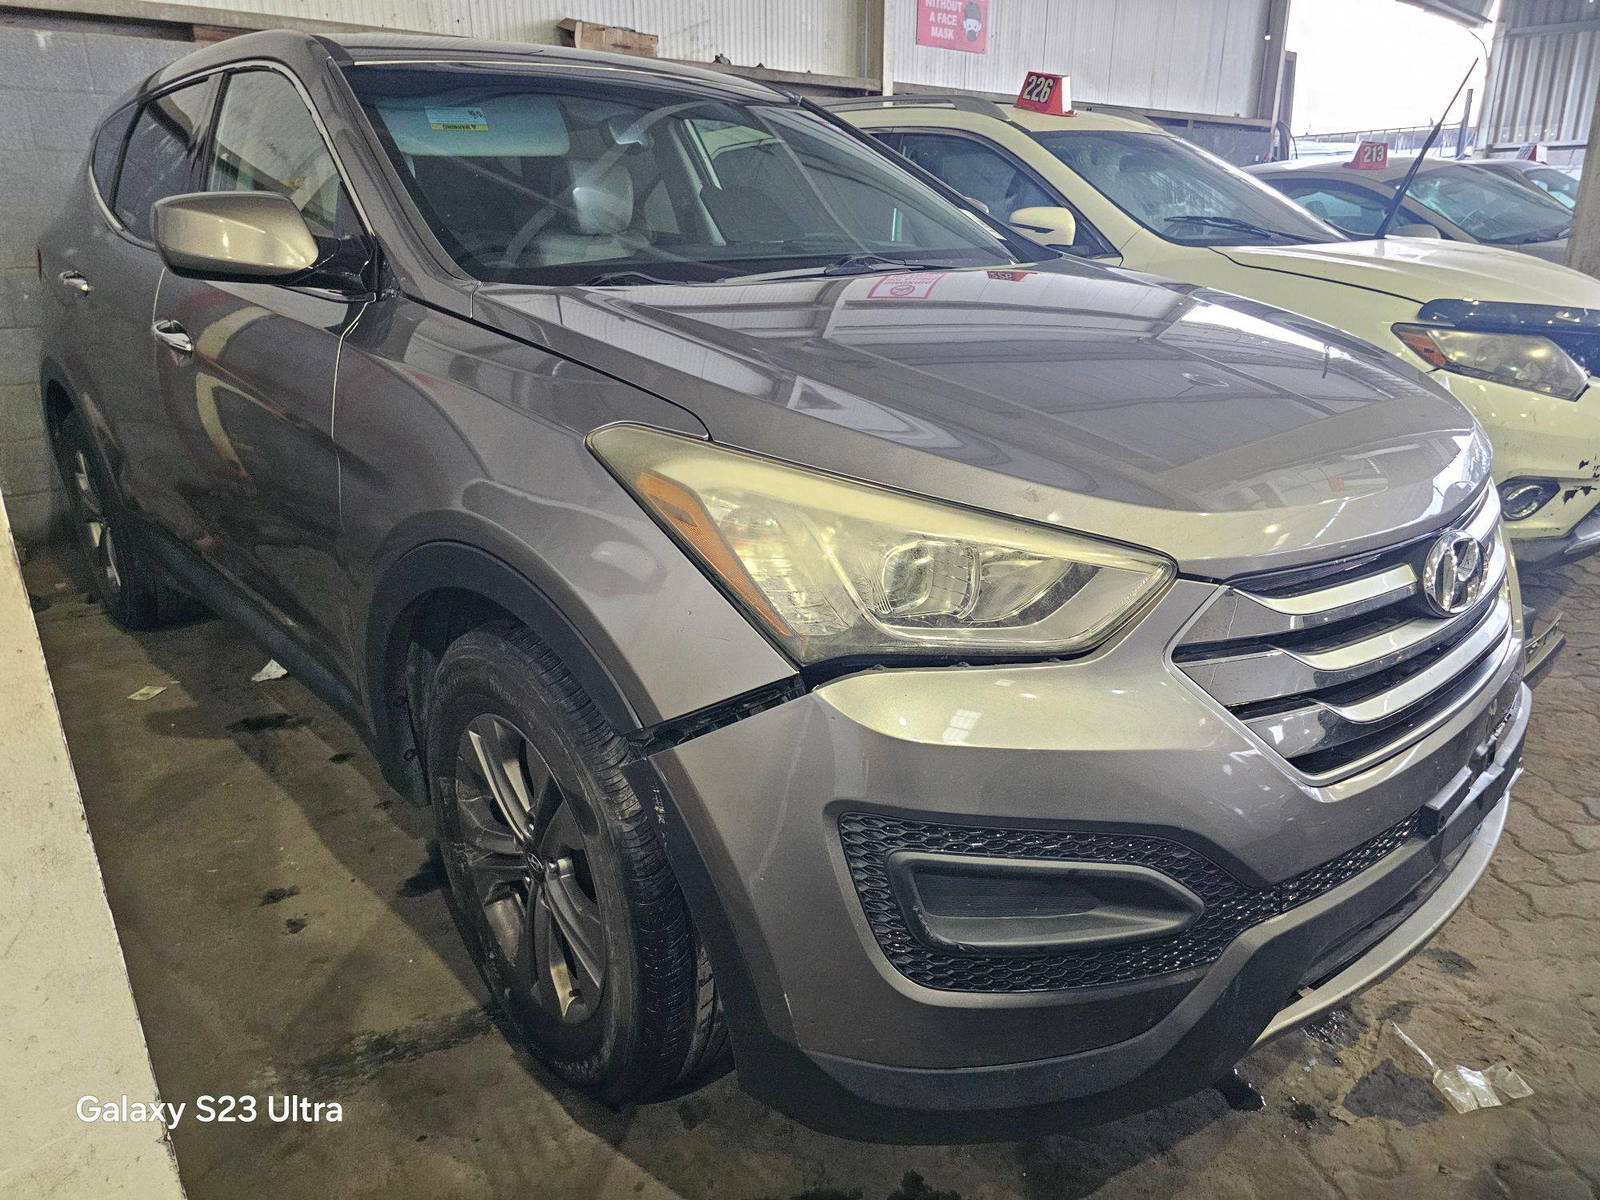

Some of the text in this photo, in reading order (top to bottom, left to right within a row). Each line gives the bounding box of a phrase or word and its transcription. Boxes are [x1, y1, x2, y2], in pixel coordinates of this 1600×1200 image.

[926, 0, 962, 12] WITHOUT
[929, 11, 958, 26] A FACE
[931, 26, 955, 40] MASK
[1023, 75, 1054, 103] 226
[1363, 145, 1384, 163] 213
